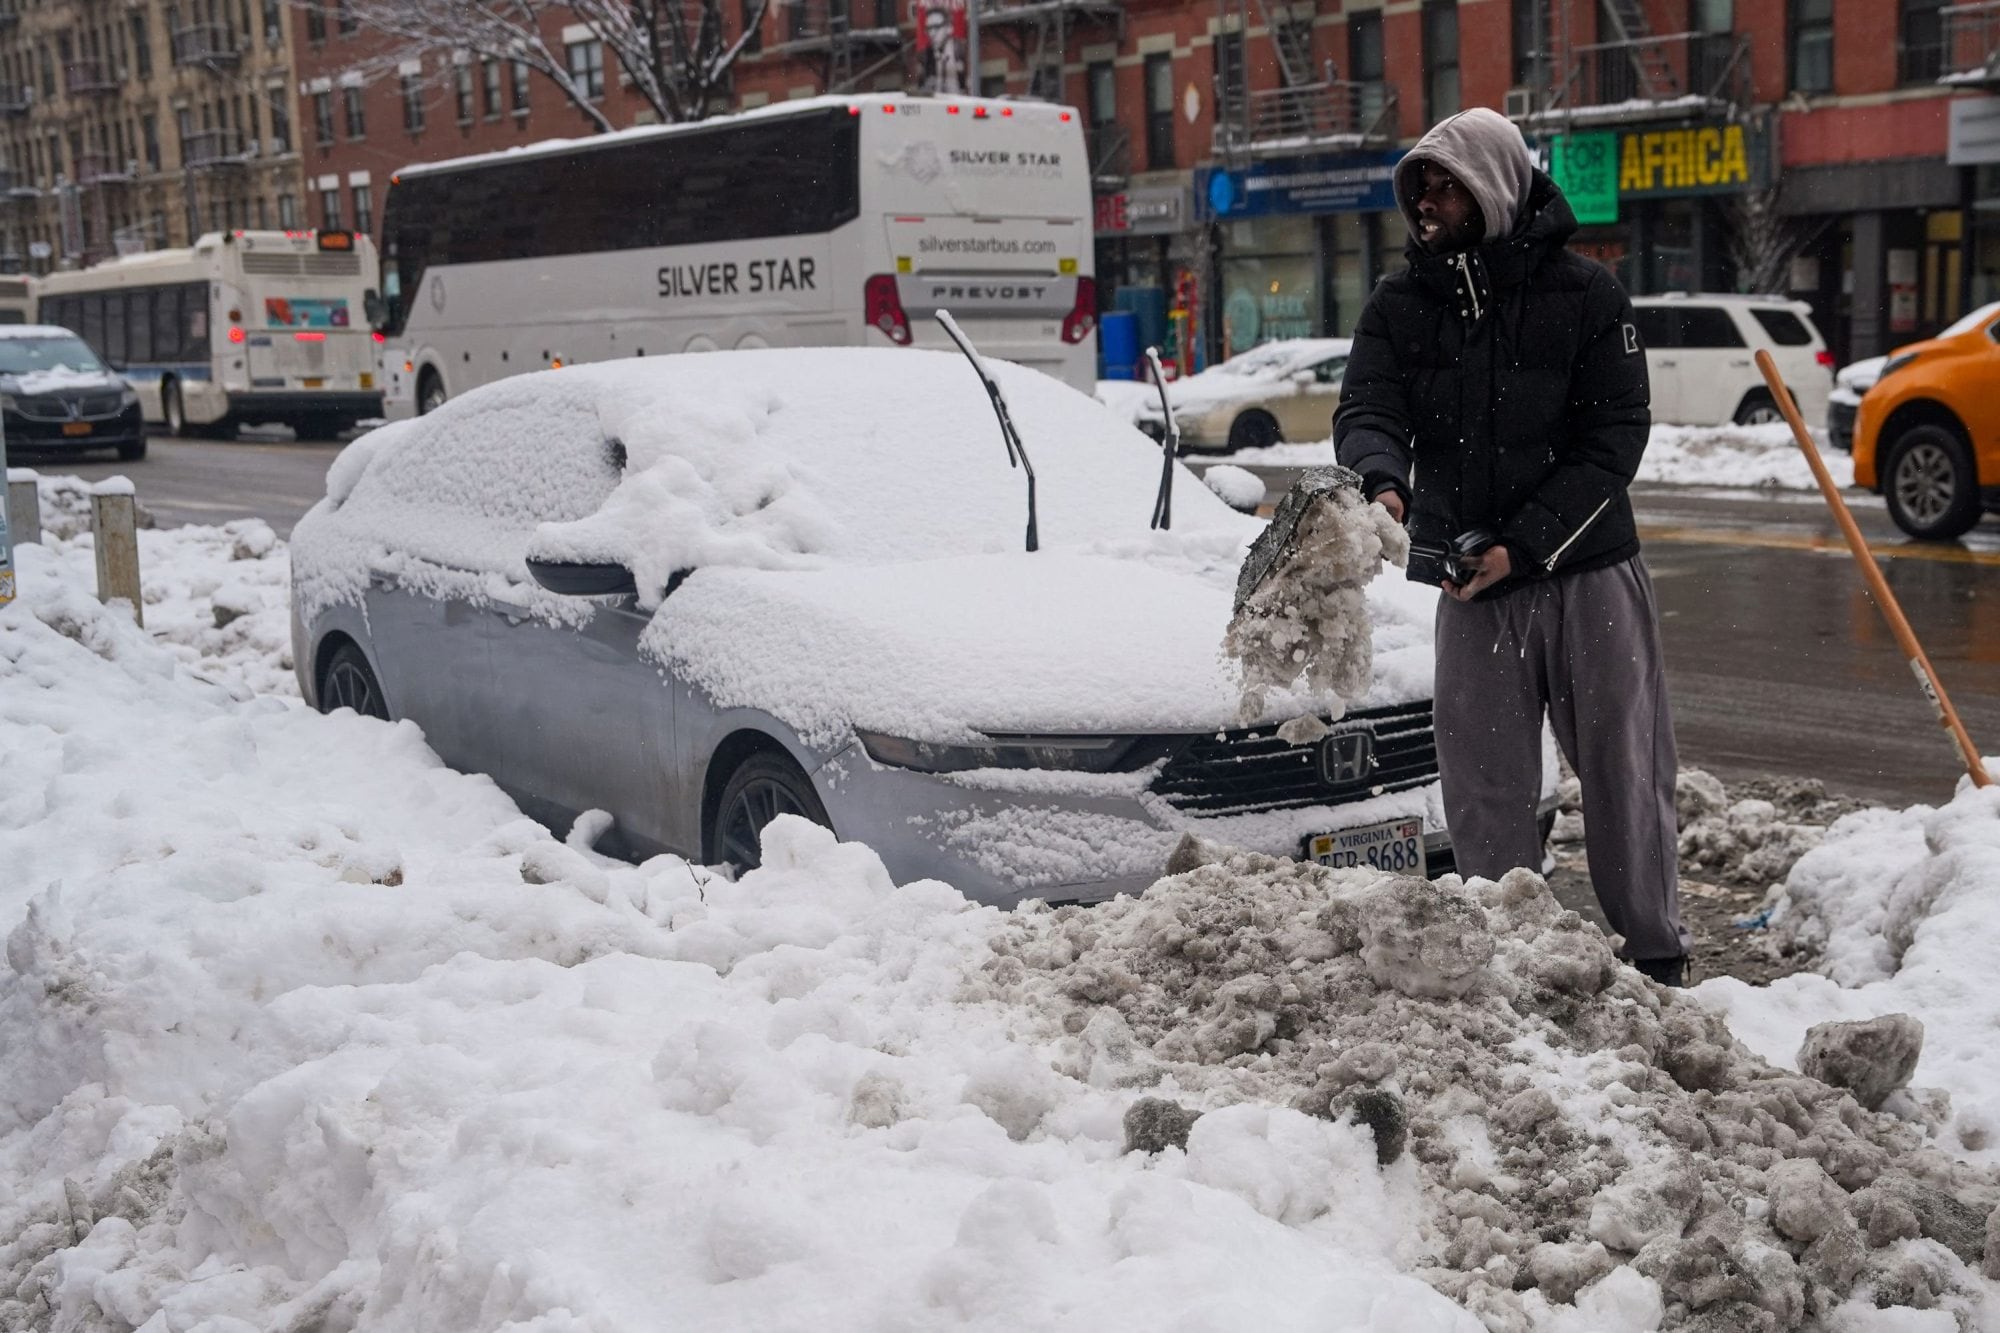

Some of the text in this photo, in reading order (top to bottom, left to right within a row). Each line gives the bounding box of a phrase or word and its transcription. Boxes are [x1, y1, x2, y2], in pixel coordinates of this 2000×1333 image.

[949, 150, 1061, 166] SILVER STAR
[1563, 142, 1606, 170] FOR
[1619, 125, 1747, 190] AFRICA
[918, 235, 1056, 254] silverstarbus.com
[658, 256, 815, 297] SILVER STAR
[931, 286, 1047, 299] PREVOST
[1340, 828, 1394, 848] VIRGINIA
